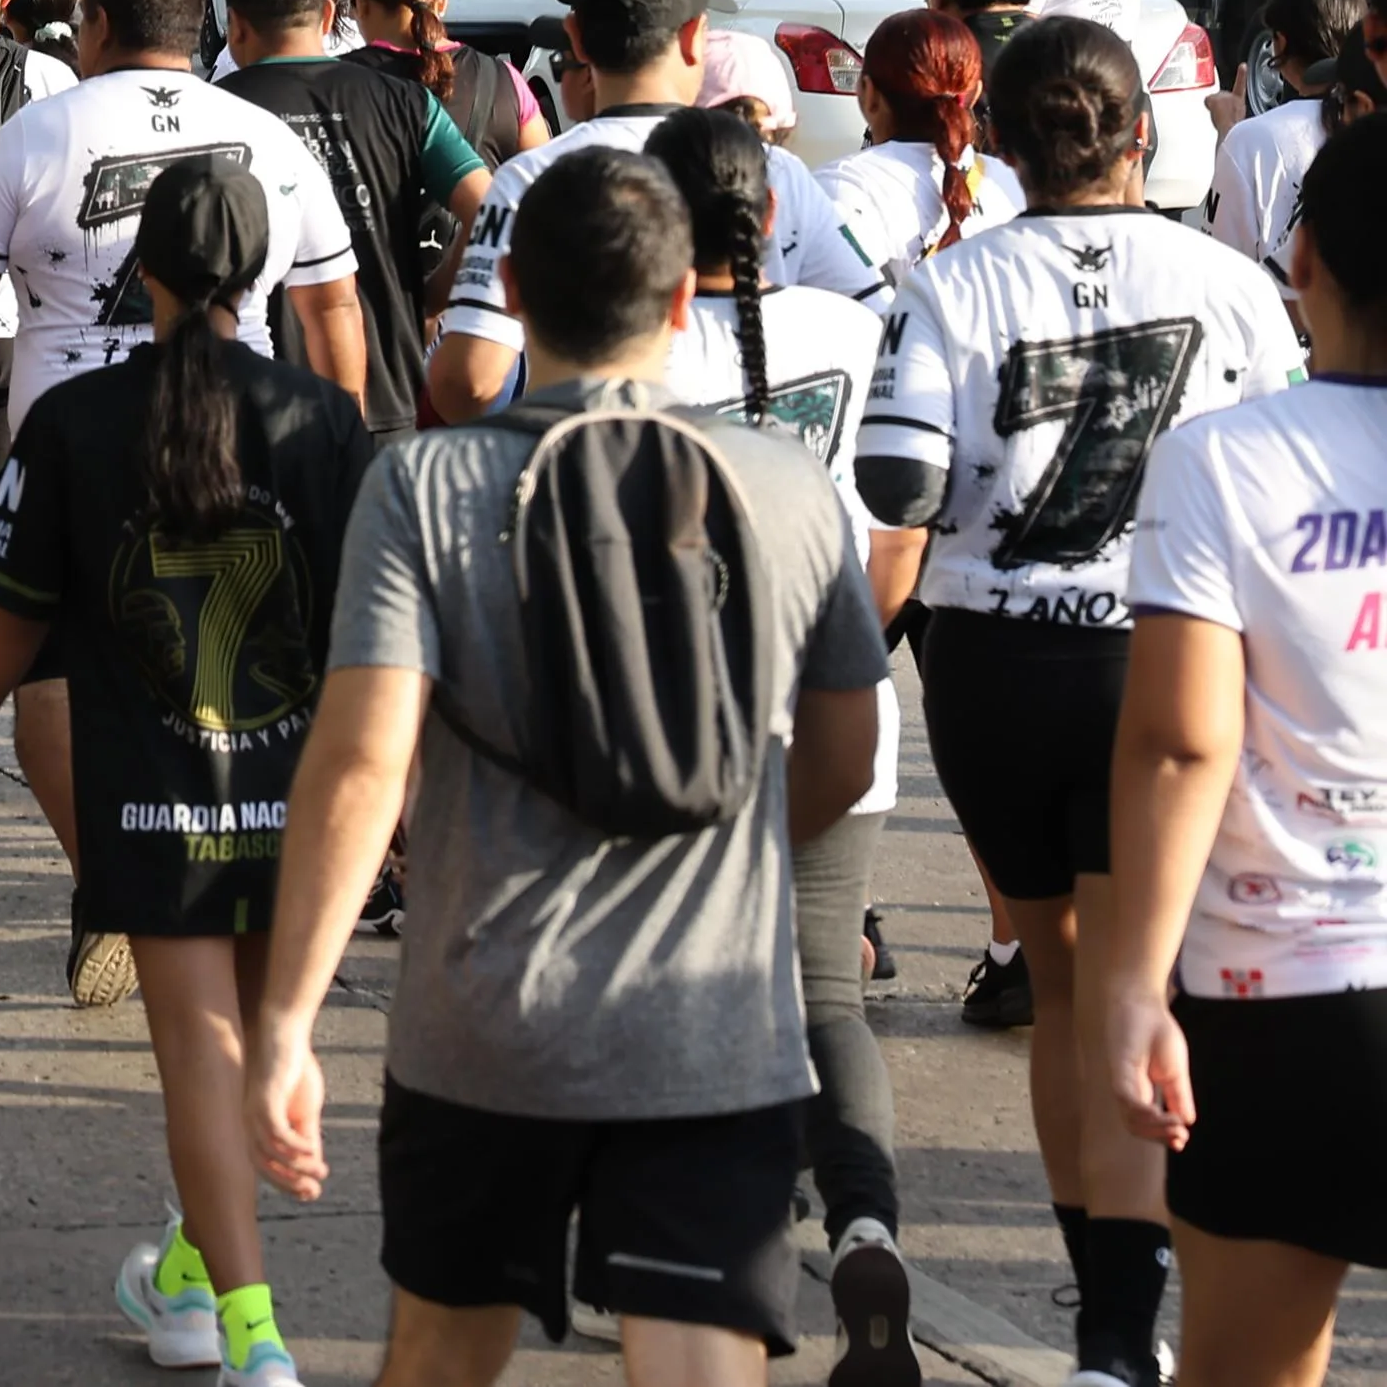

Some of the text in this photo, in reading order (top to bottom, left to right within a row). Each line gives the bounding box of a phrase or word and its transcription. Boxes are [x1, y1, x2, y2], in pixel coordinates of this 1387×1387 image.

[150, 113, 181, 133] GN
[1072, 281, 1110, 310] GN
[161, 712, 254, 755] JUSTICIA
[257, 729, 272, 748] Y
[120, 802, 238, 833] GUARDIA
